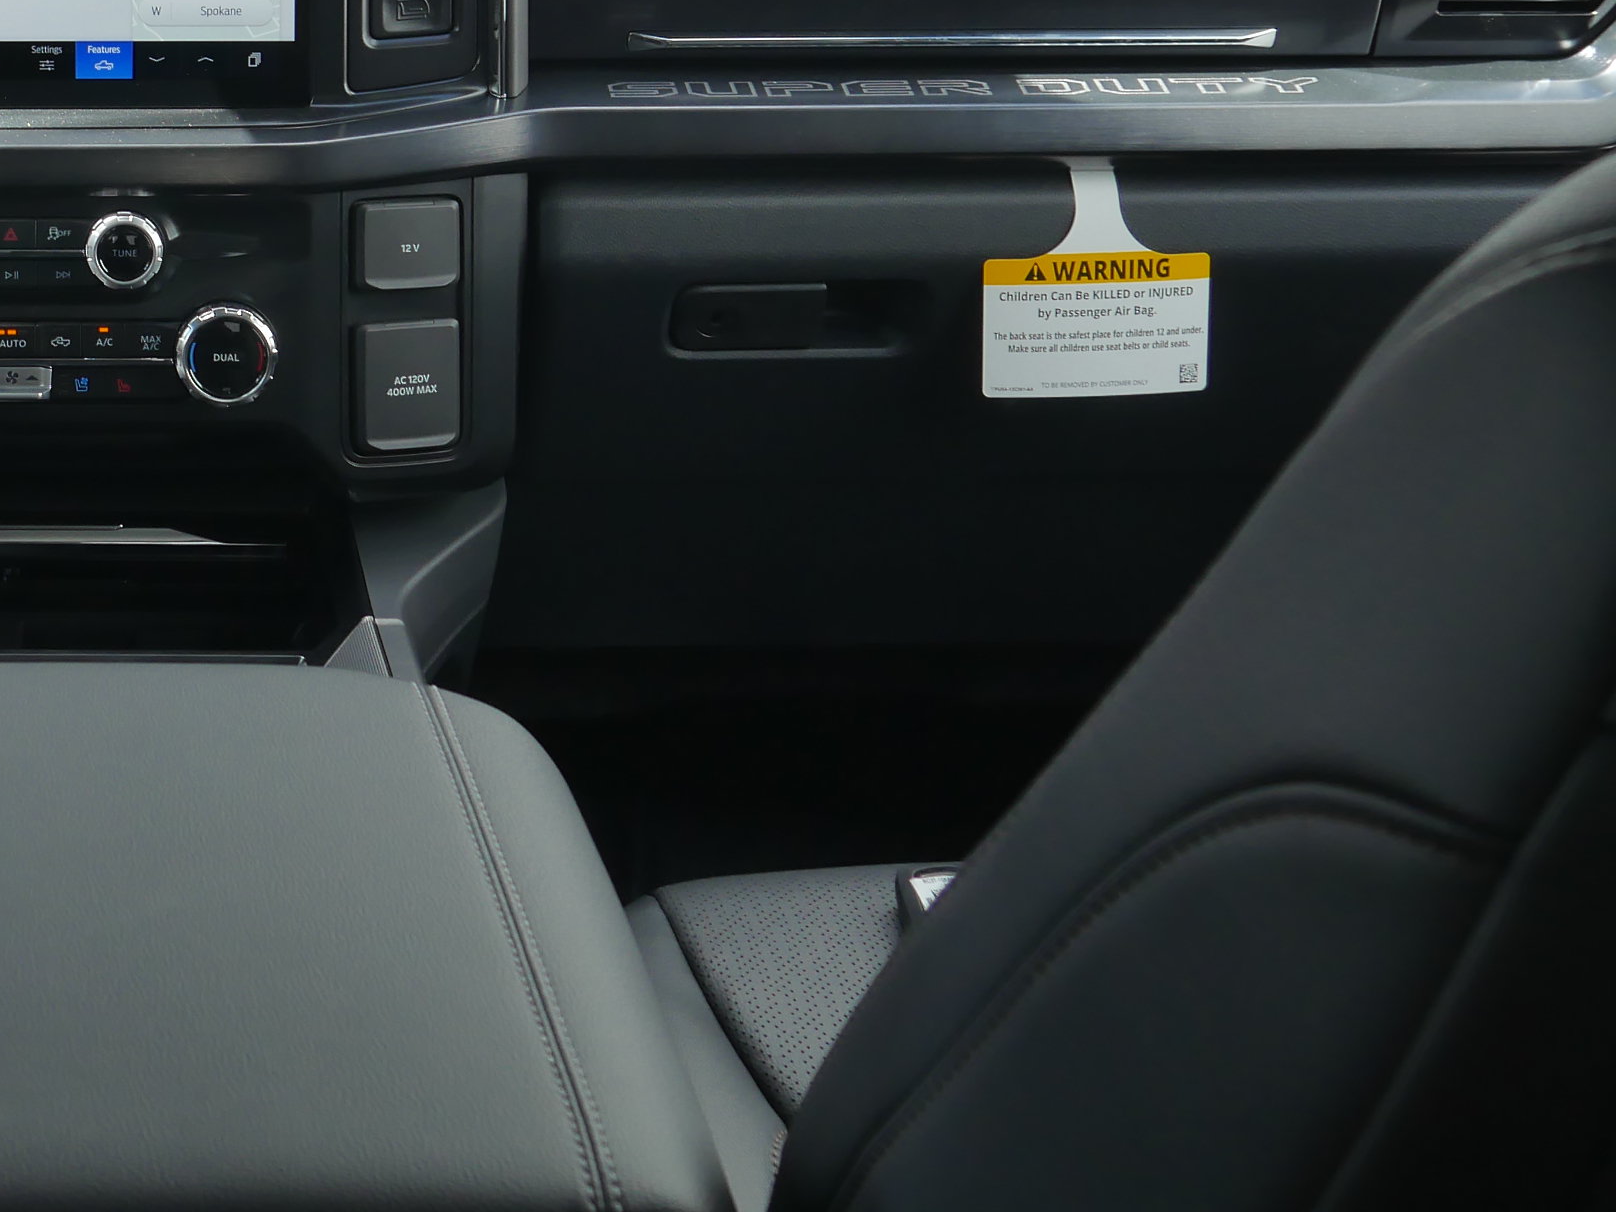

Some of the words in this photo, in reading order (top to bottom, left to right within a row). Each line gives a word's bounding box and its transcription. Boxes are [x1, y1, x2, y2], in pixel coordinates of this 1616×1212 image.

[151, 5, 162, 16] W
[200, 5, 242, 19] Spokane
[30, 45, 63, 57] Settings
[87, 45, 121, 55] Features
[607, 79, 993, 98] SUPER
[1015, 77, 1318, 95] DUTY
[58, 229, 71, 238] OFF
[112, 248, 137, 258] TUNE
[401, 244, 411, 253] 12
[412, 244, 420, 253] V
[1052, 258, 1170, 282] WARNING
[999, 291, 1048, 302] Children
[1051, 291, 1072, 301] Can
[1076, 290, 1090, 300] Be
[1093, 289, 1131, 300] KILLED
[1134, 290, 1146, 299] or
[1148, 286, 1194, 299] INJURED
[1038, 308, 1052, 321] by
[1055, 307, 1112, 320] Passenger
[1114, 306, 1131, 316] Air
[1134, 305, 1157, 318] Bag.
[994, 332, 1008, 340] The
[1009, 331, 1027, 340] back
[1028, 332, 1045, 340] seat
[1046, 331, 1053, 339] is
[1054, 331, 1067, 339] the
[1068, 330, 1091, 339] safest
[1092, 330, 1111, 340] place
[1113, 329, 1124, 339] for
[1125, 328, 1155, 338] children
[1157, 328, 1165, 336] 12
[1166, 326, 1180, 336] and
[1181, 325, 1204, 335] under.
[0, 338, 27, 349] AUTO
[96, 337, 114, 348] A/C
[140, 335, 162, 345] MAX
[142, 342, 161, 352] A/C
[1008, 345, 1029, 353] Make
[1049, 344, 1058, 352] all
[1060, 344, 1090, 352] children
[1106, 343, 1122, 351] seat
[1123, 341, 1141, 351] belts
[1142, 342, 1151, 350] or
[1152, 340, 1169, 349] child
[1170, 339, 1191, 348] seats.
[213, 352, 240, 363] DUAL
[394, 376, 407, 385] AC
[408, 374, 430, 385] 120V
[1100, 380, 1132, 388] CUSTOMER
[387, 387, 415, 397] 400W
[416, 384, 437, 395] MAX
